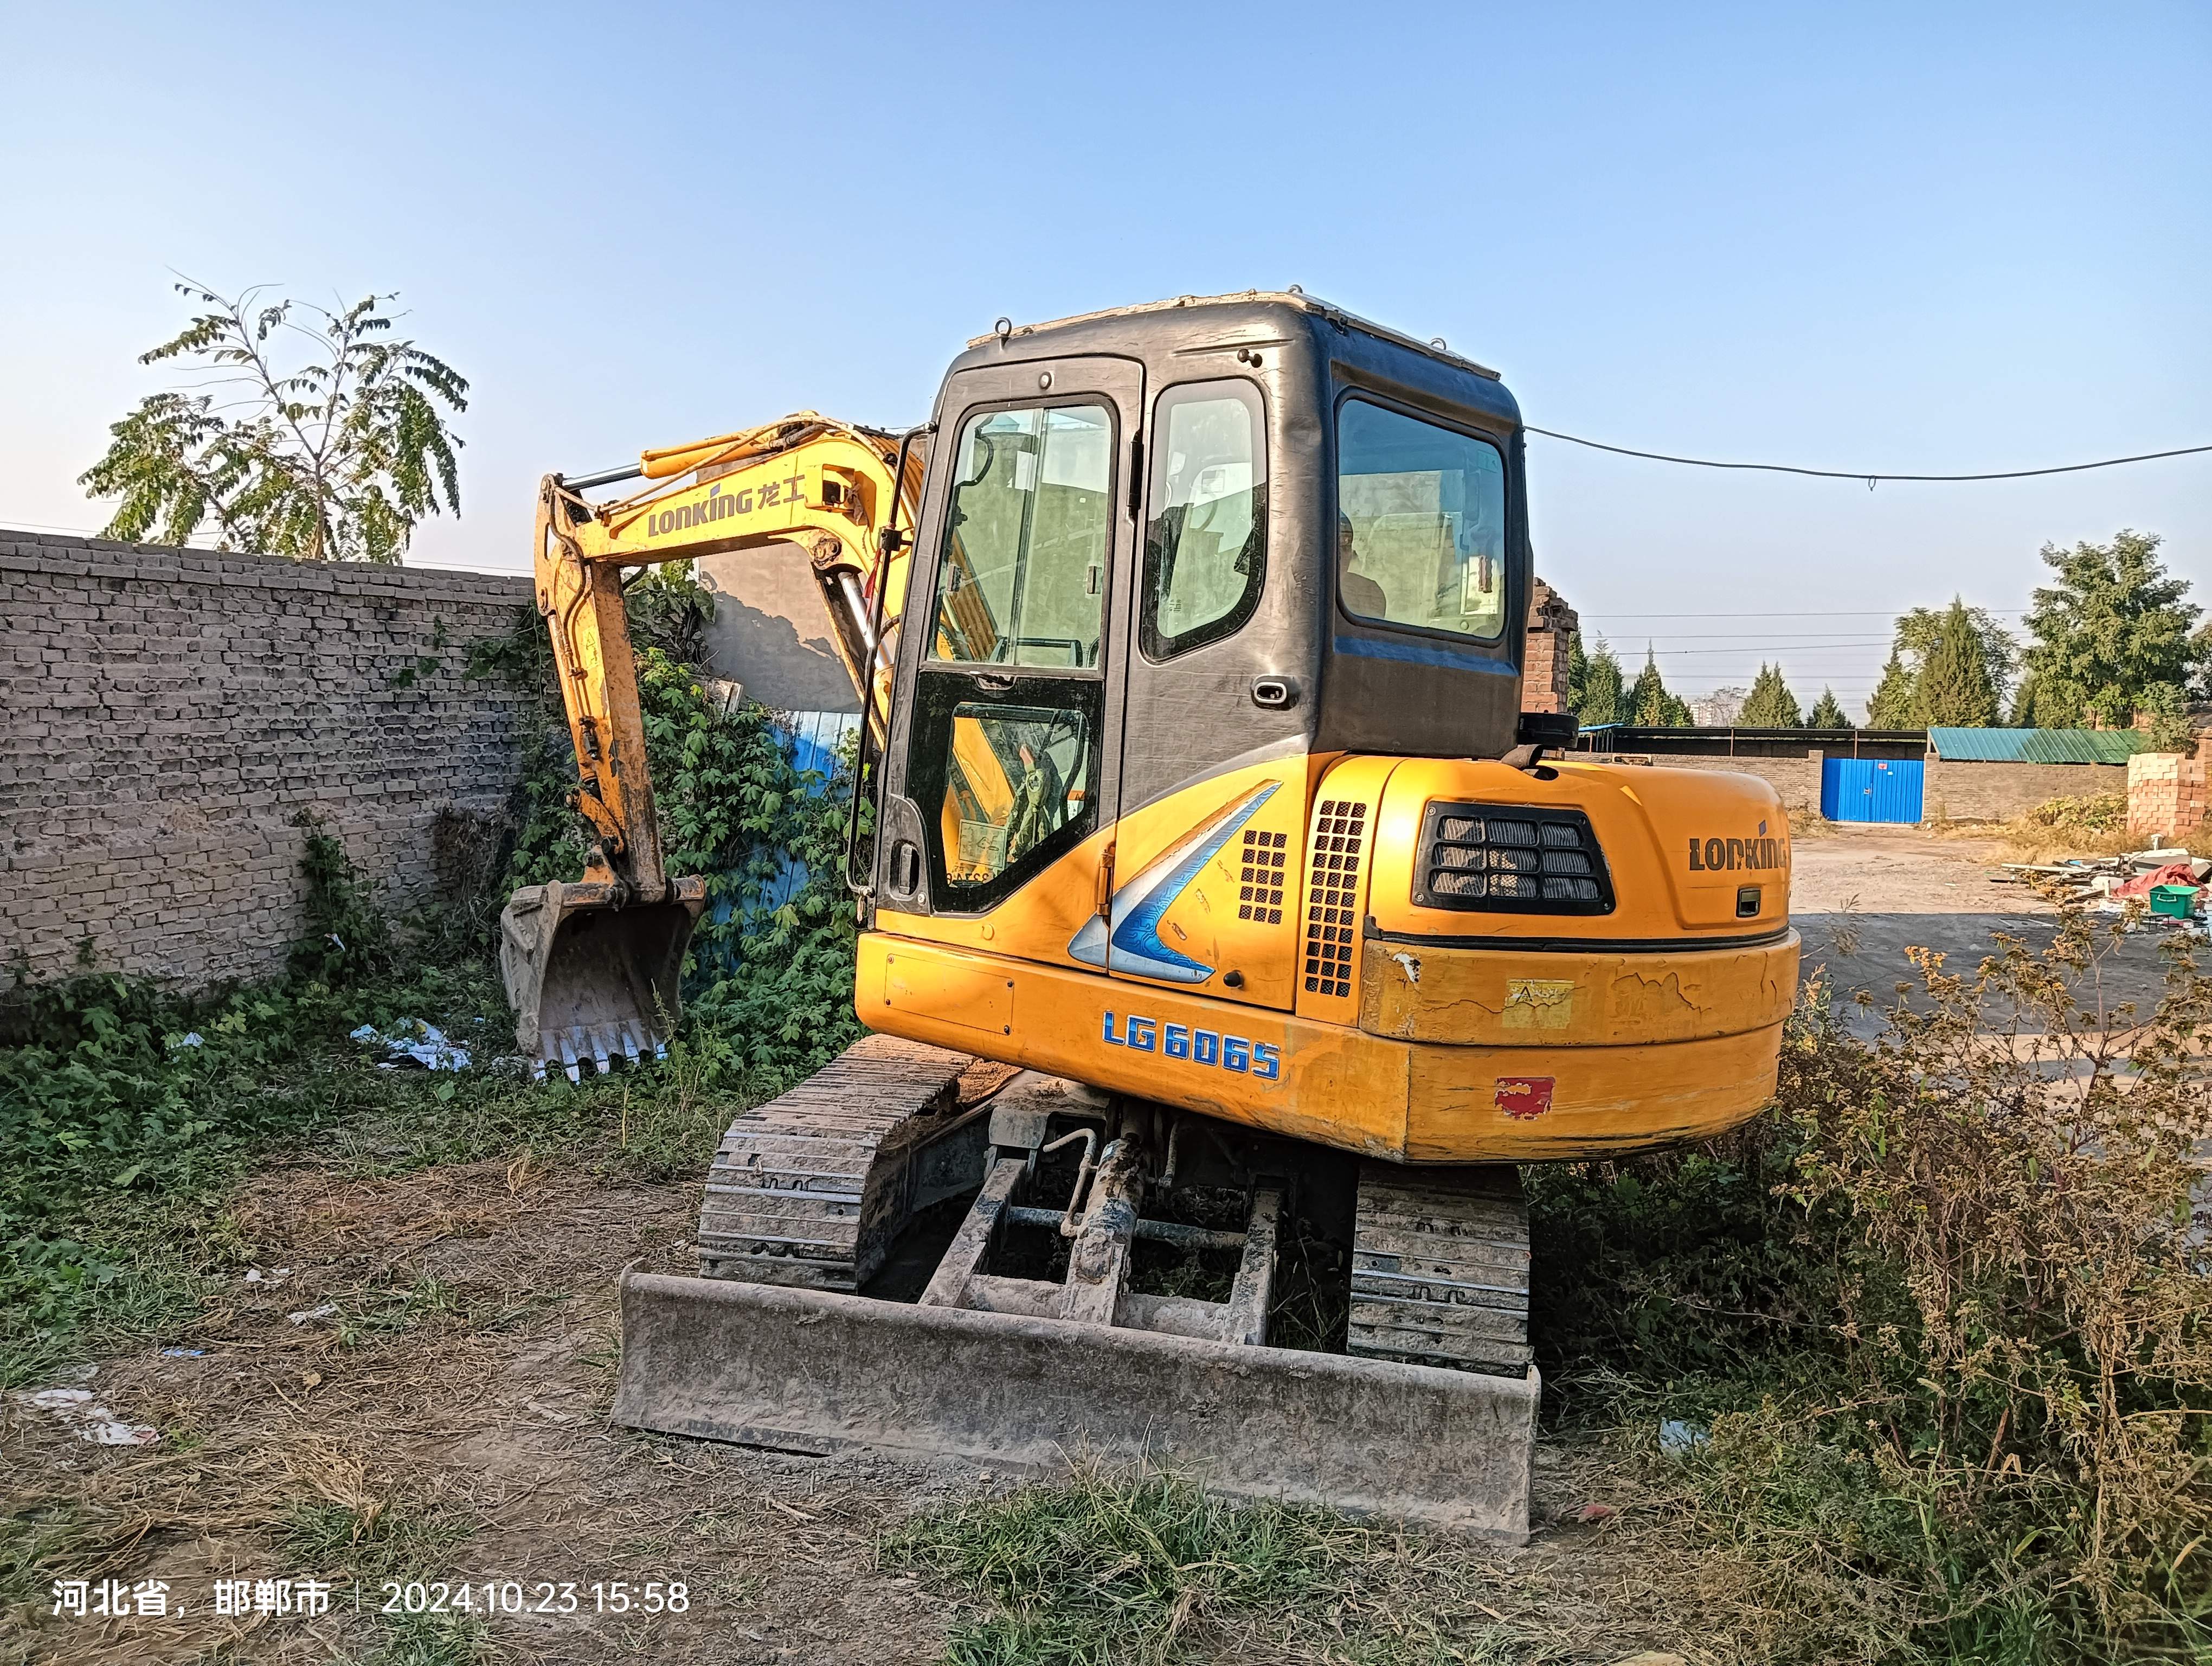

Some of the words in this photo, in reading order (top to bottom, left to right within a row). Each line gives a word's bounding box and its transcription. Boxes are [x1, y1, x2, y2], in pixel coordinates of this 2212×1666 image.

[648, 483, 753, 537] LONKING
[758, 475, 805, 509] 龙工
[1689, 819, 1787, 871] LONKING
